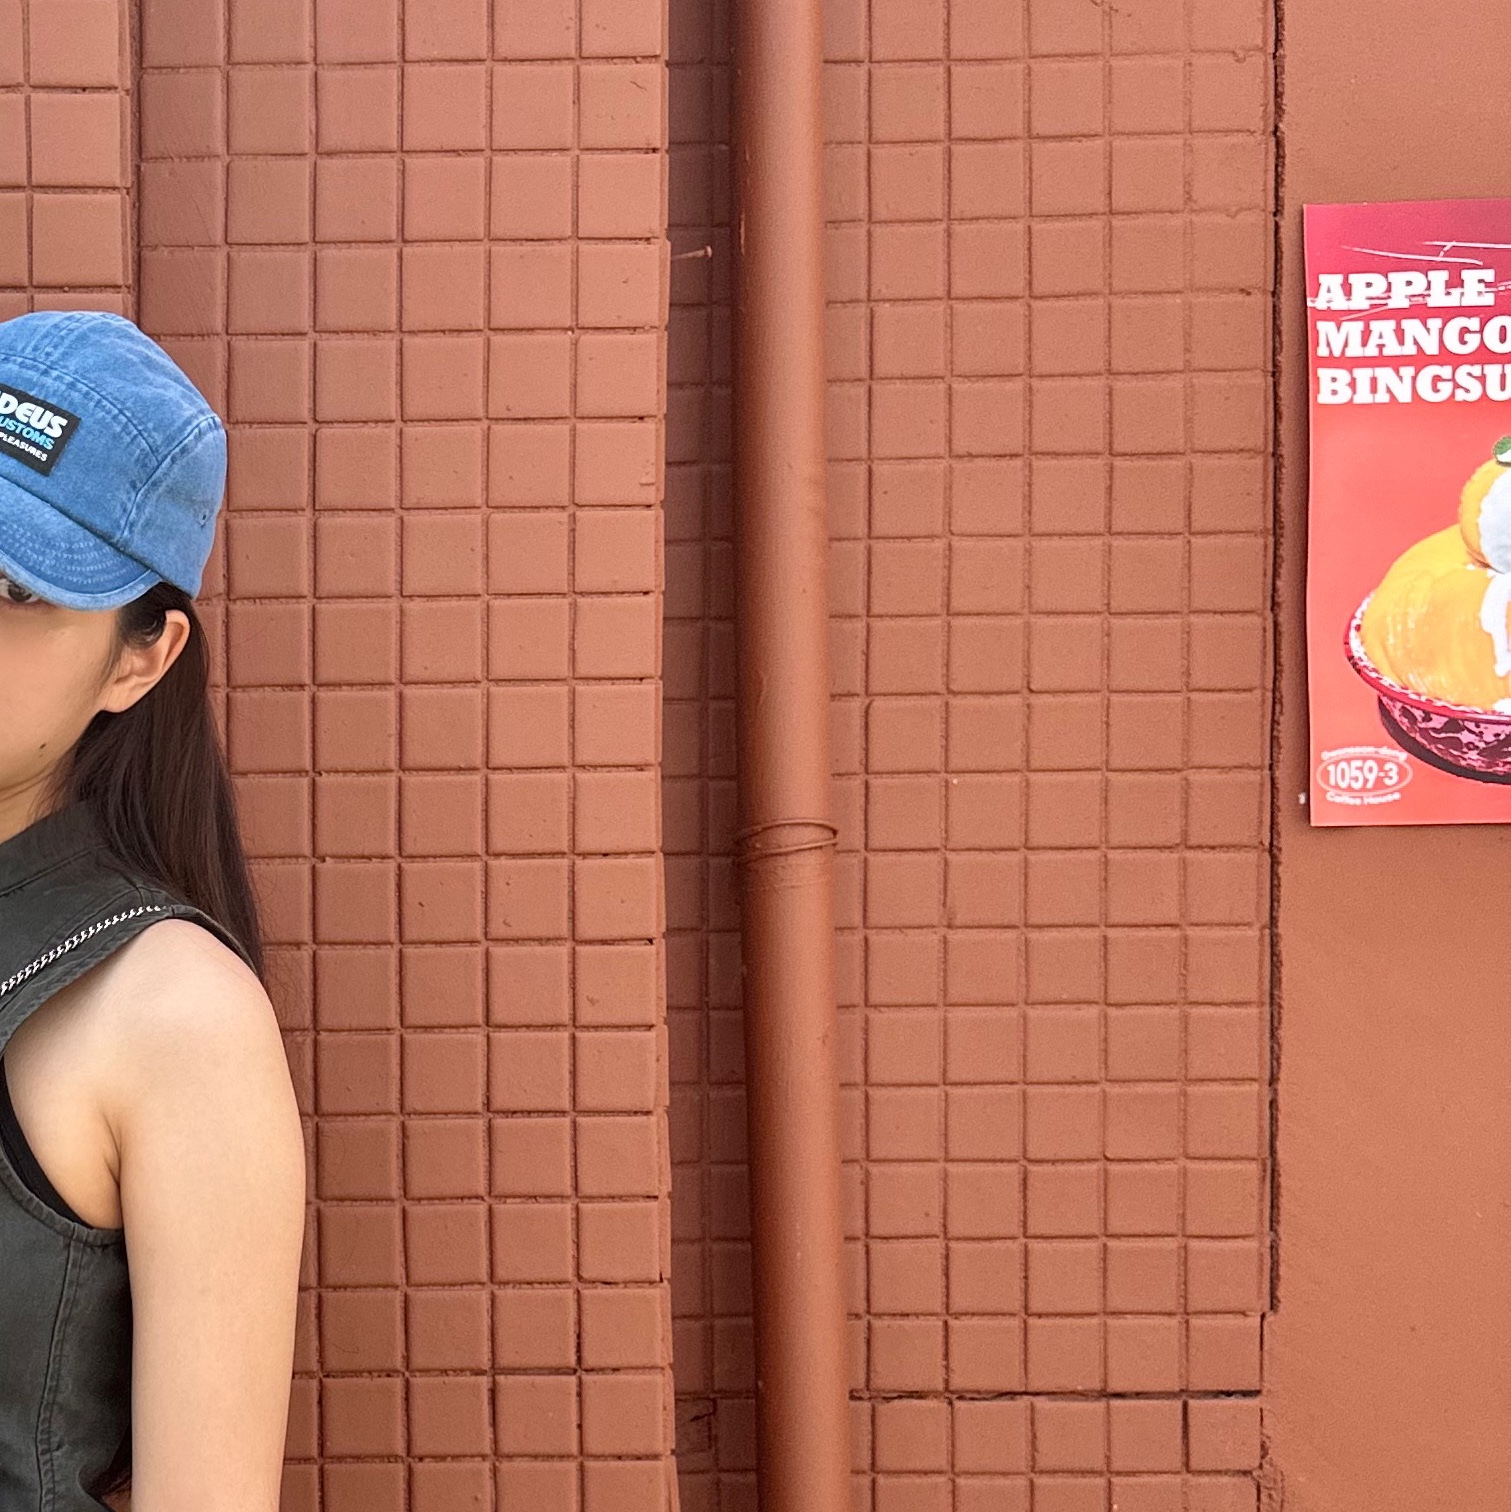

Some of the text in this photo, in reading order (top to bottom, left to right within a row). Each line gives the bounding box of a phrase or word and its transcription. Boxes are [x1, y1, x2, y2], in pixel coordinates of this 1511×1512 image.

[1316, 269, 1495, 310] APPLE
[1316, 315, 1511, 358] MANGO
[1326, 759, 1399, 791] 1059-3
